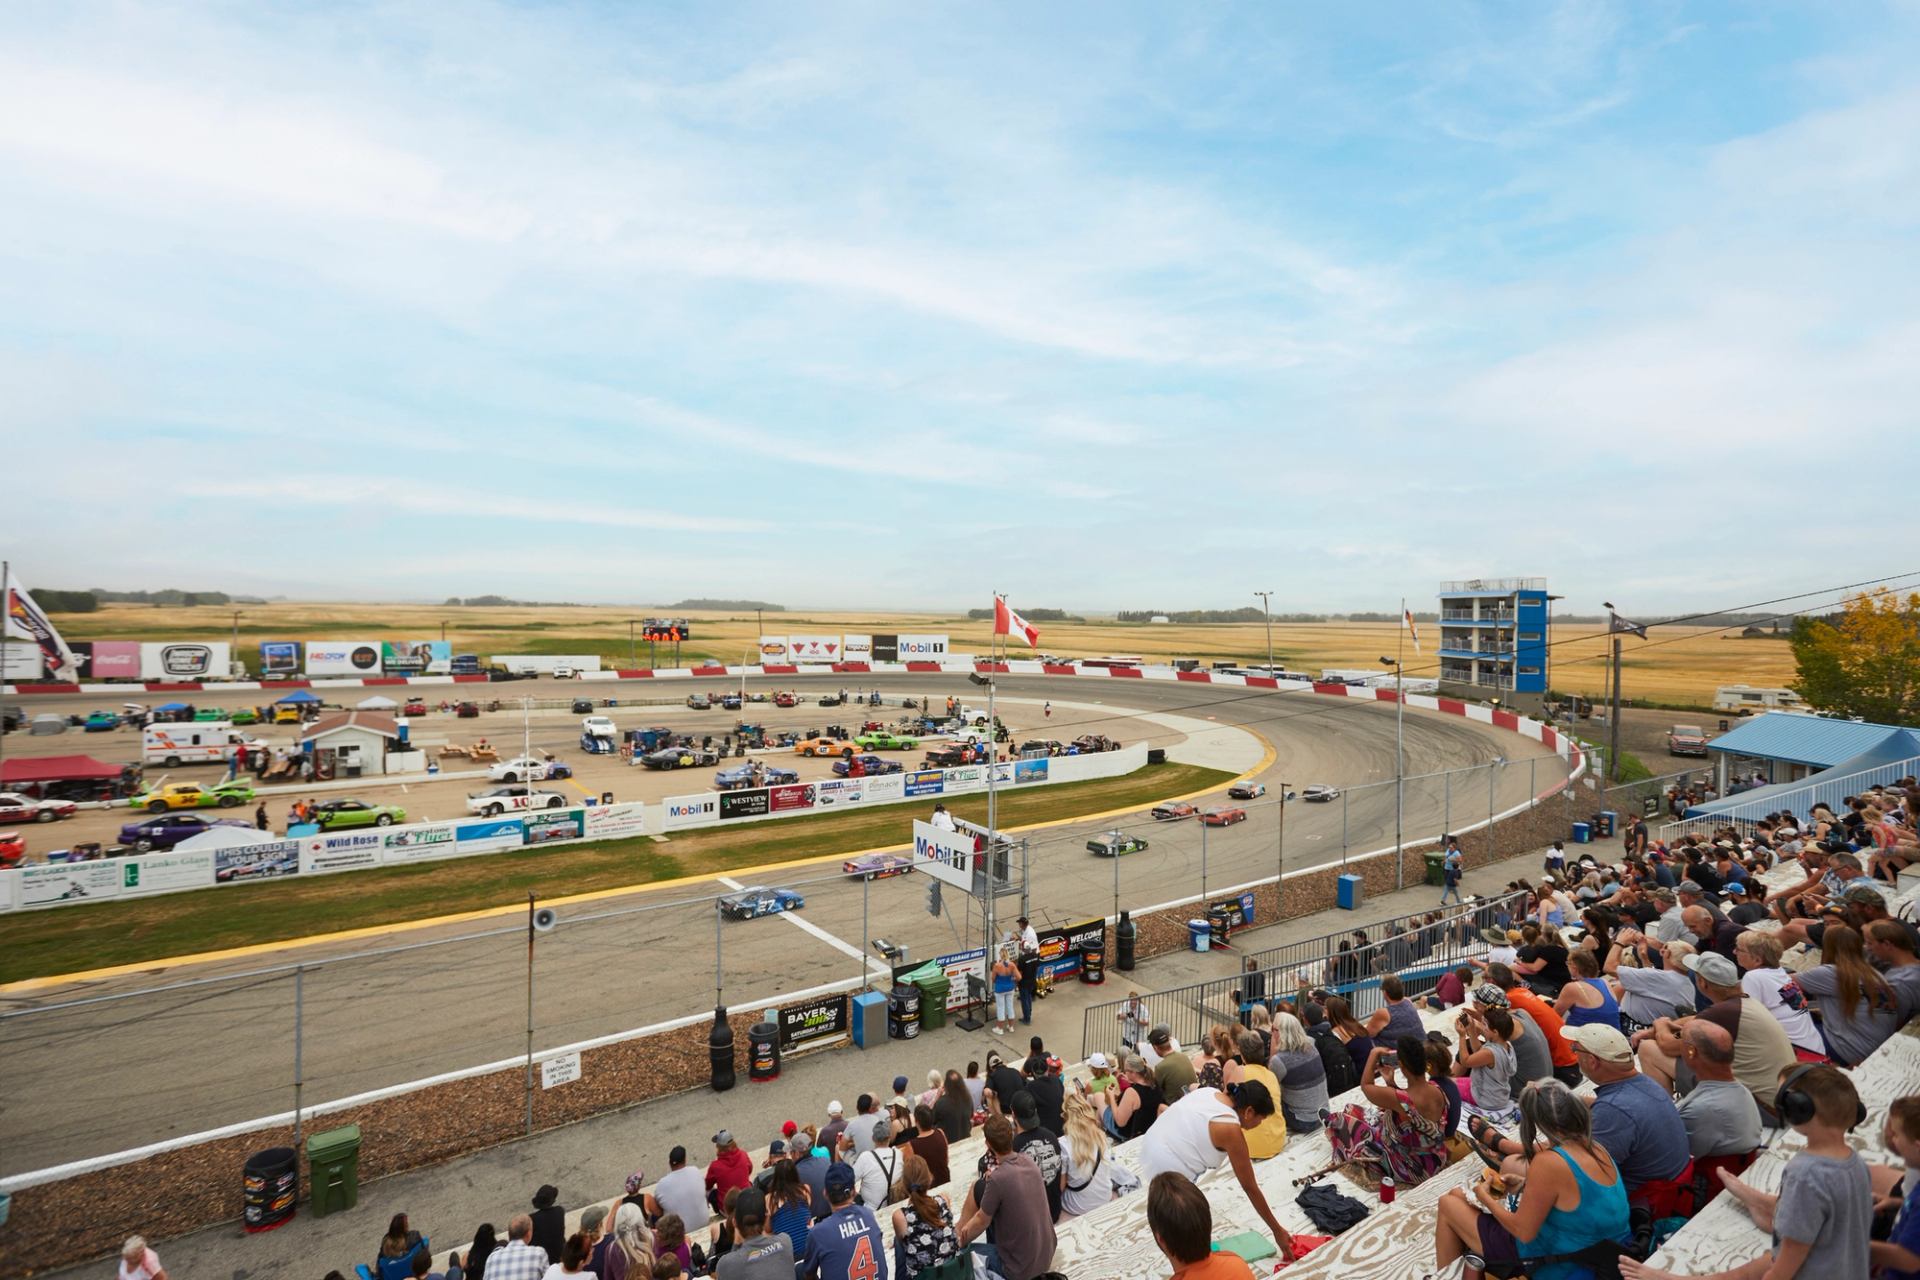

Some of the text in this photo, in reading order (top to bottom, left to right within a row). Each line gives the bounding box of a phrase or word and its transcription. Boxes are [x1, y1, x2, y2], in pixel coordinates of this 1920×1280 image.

[900, 643, 931, 653] Mobil
[731, 795, 767, 805] WESTVIEW
[670, 804, 701, 817] Mobil
[326, 835, 379, 849] Wild Rose
[217, 841, 297, 859] THIS COULD BE
[916, 836, 951, 866] Mobil
[228, 852, 288, 865] YOUR SIGN
[758, 900, 775, 912] 27
[1070, 930, 1103, 944] WELCOME
[951, 954, 970, 962] GARAGE
[787, 1007, 827, 1024] BAYER
[545, 1062, 576, 1074] SMOKING
[552, 1076, 570, 1085] AREA
[839, 1220, 871, 1239] HALL
[848, 1234, 880, 1280] 4
